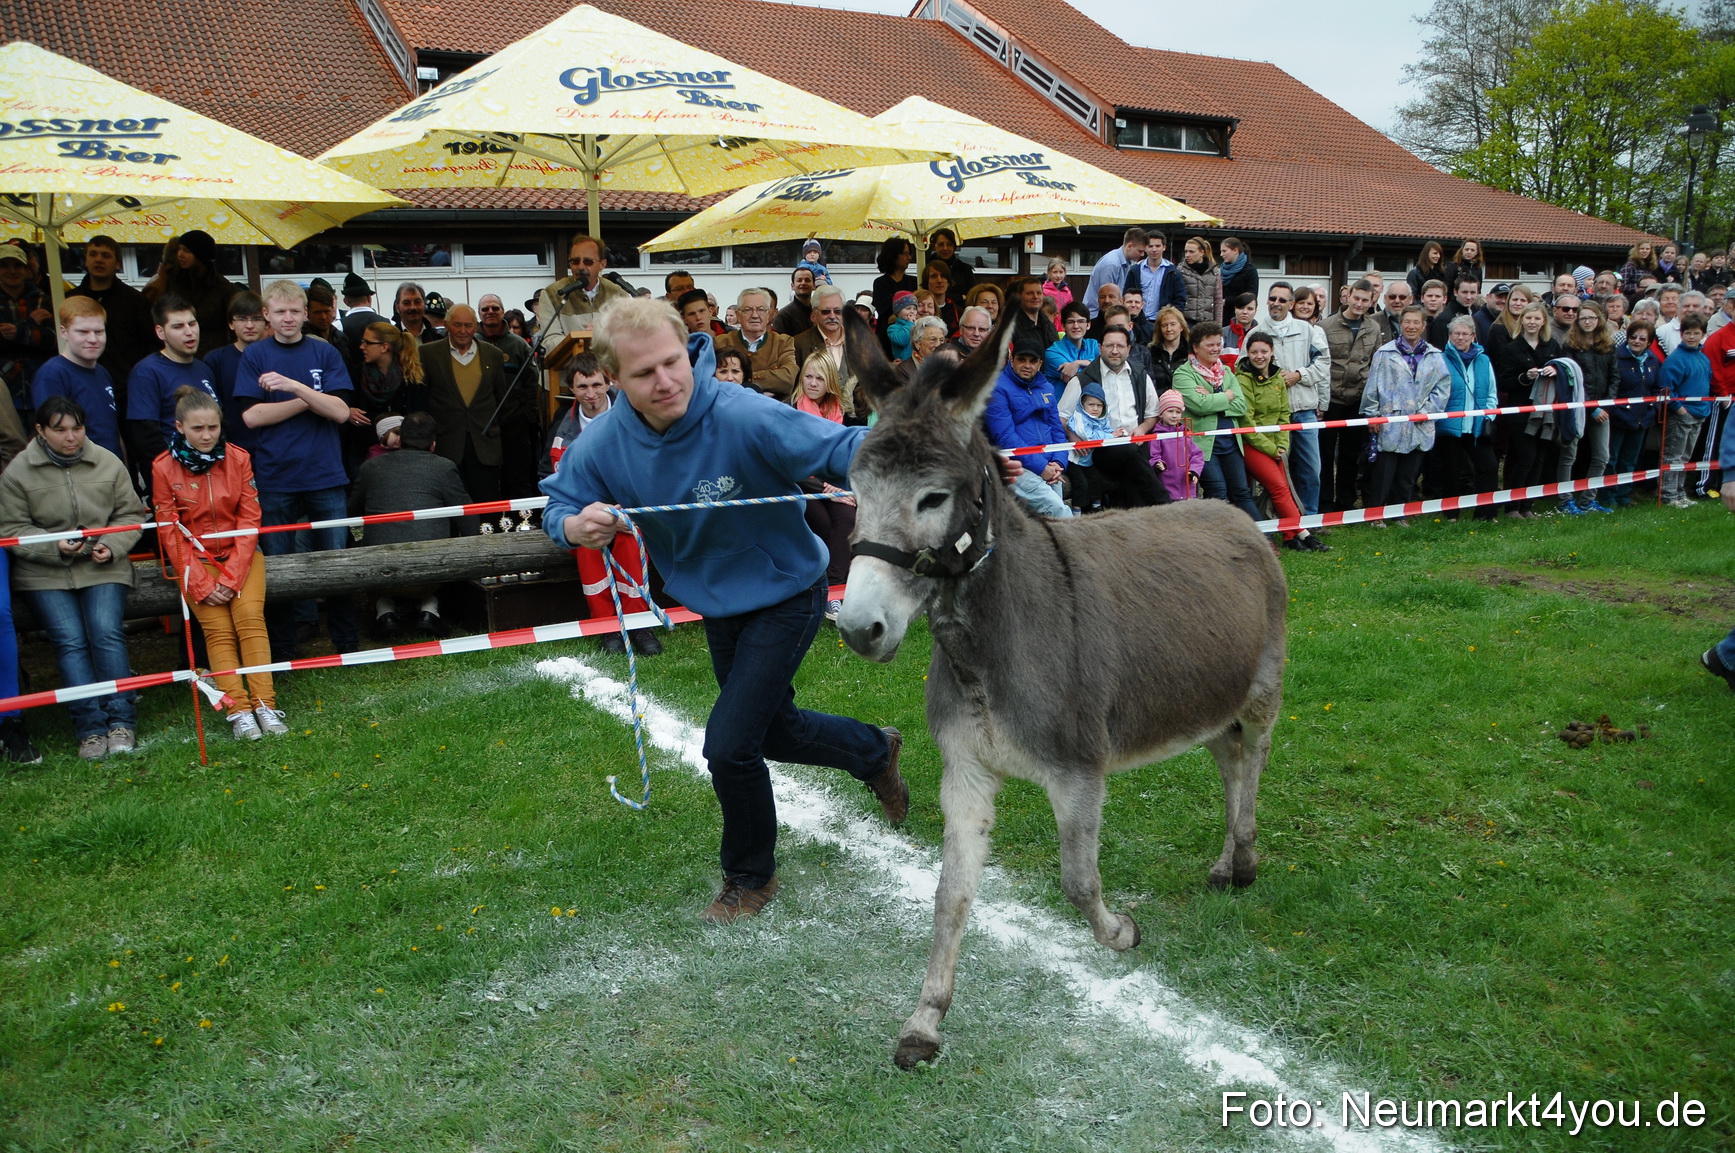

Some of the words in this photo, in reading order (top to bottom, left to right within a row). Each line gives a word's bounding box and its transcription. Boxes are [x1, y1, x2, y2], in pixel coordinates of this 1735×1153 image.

[559, 67, 734, 106] Glossner
[676, 89, 764, 113] Bier
[556, 107, 602, 119] Der
[610, 109, 702, 123] hochfeine
[711, 110, 818, 131] Biergenuss
[57, 140, 181, 165] Bier
[82, 164, 234, 184] Biergenuss
[929, 152, 1045, 193] Glossner
[1016, 171, 1077, 192] Bier
[773, 182, 833, 202] Bier
[940, 194, 974, 205] Der
[979, 191, 1042, 205] hochfeine
